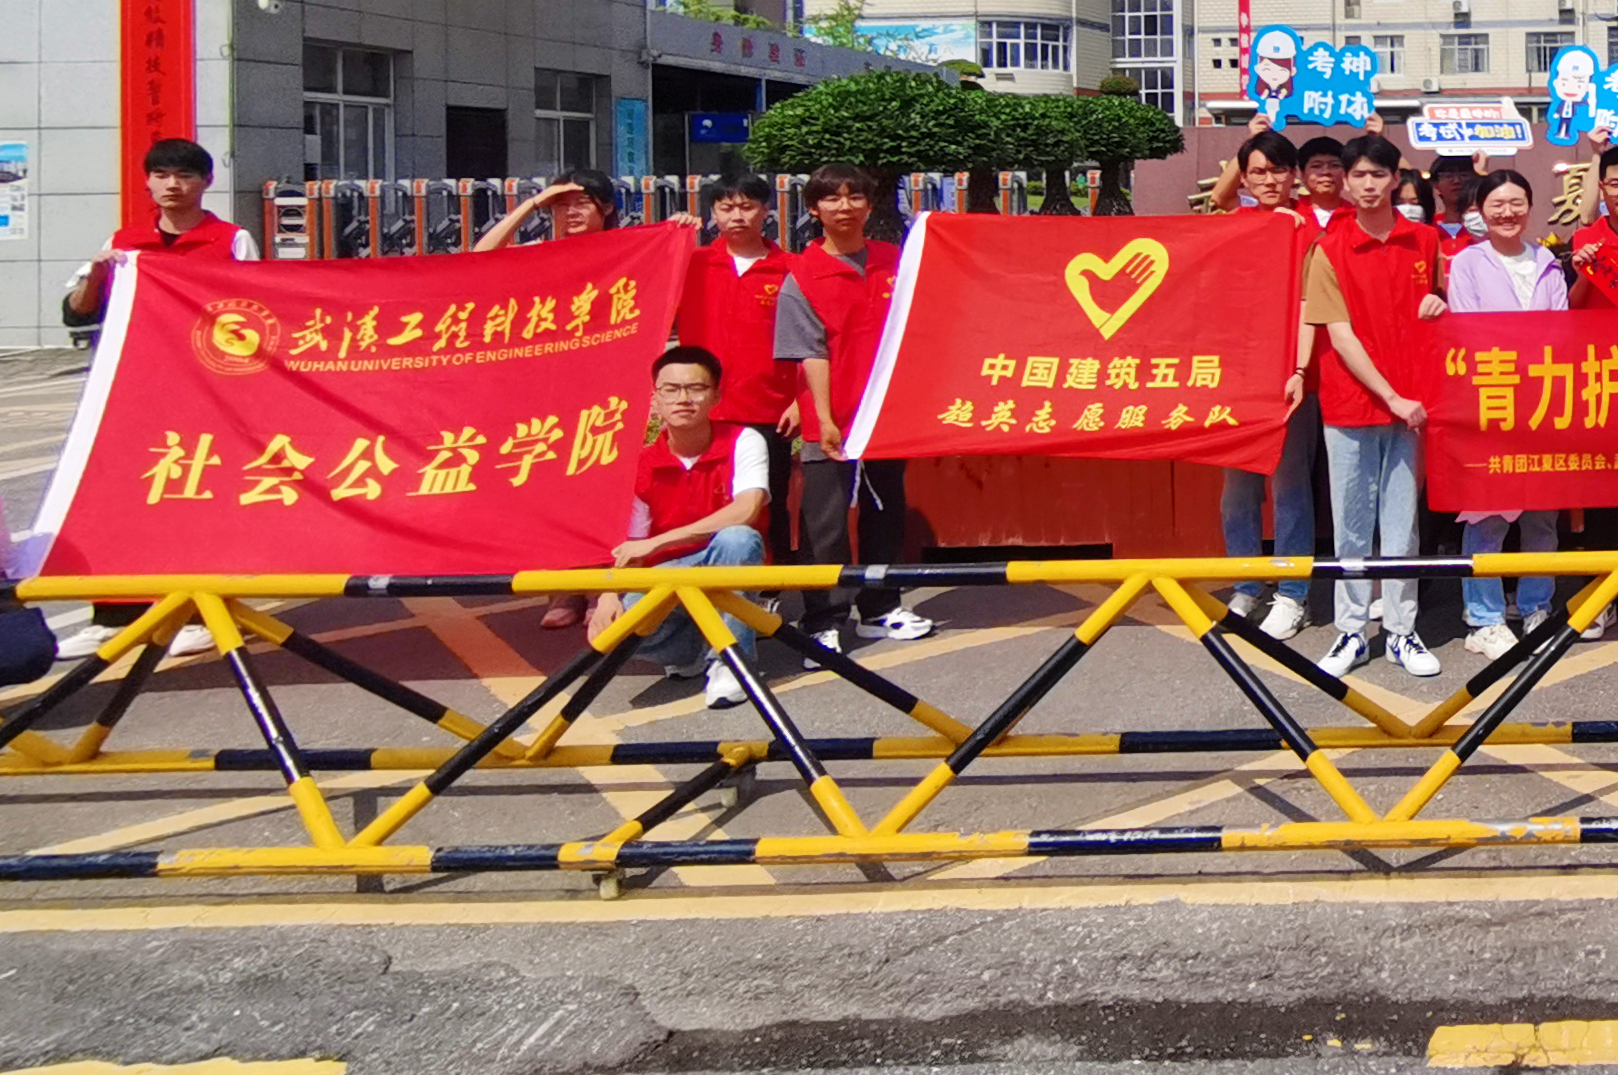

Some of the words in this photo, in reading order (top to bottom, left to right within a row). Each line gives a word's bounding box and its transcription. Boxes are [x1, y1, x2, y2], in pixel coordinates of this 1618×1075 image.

[1307, 46, 1373, 82] 考神
[1302, 90, 1370, 121] 附体
[285, 359, 348, 373] WUHAN
[351, 354, 451, 372] UNIVERSITY
[451, 351, 476, 366] OF
[475, 337, 583, 364] ENGINEERING
[581, 322, 640, 348] SCIENCE
[980, 353, 1222, 390] 中国建筑五局
[936, 397, 1240, 434] 超英志愿服务队
[141, 396, 629, 506] 社会公益学院
